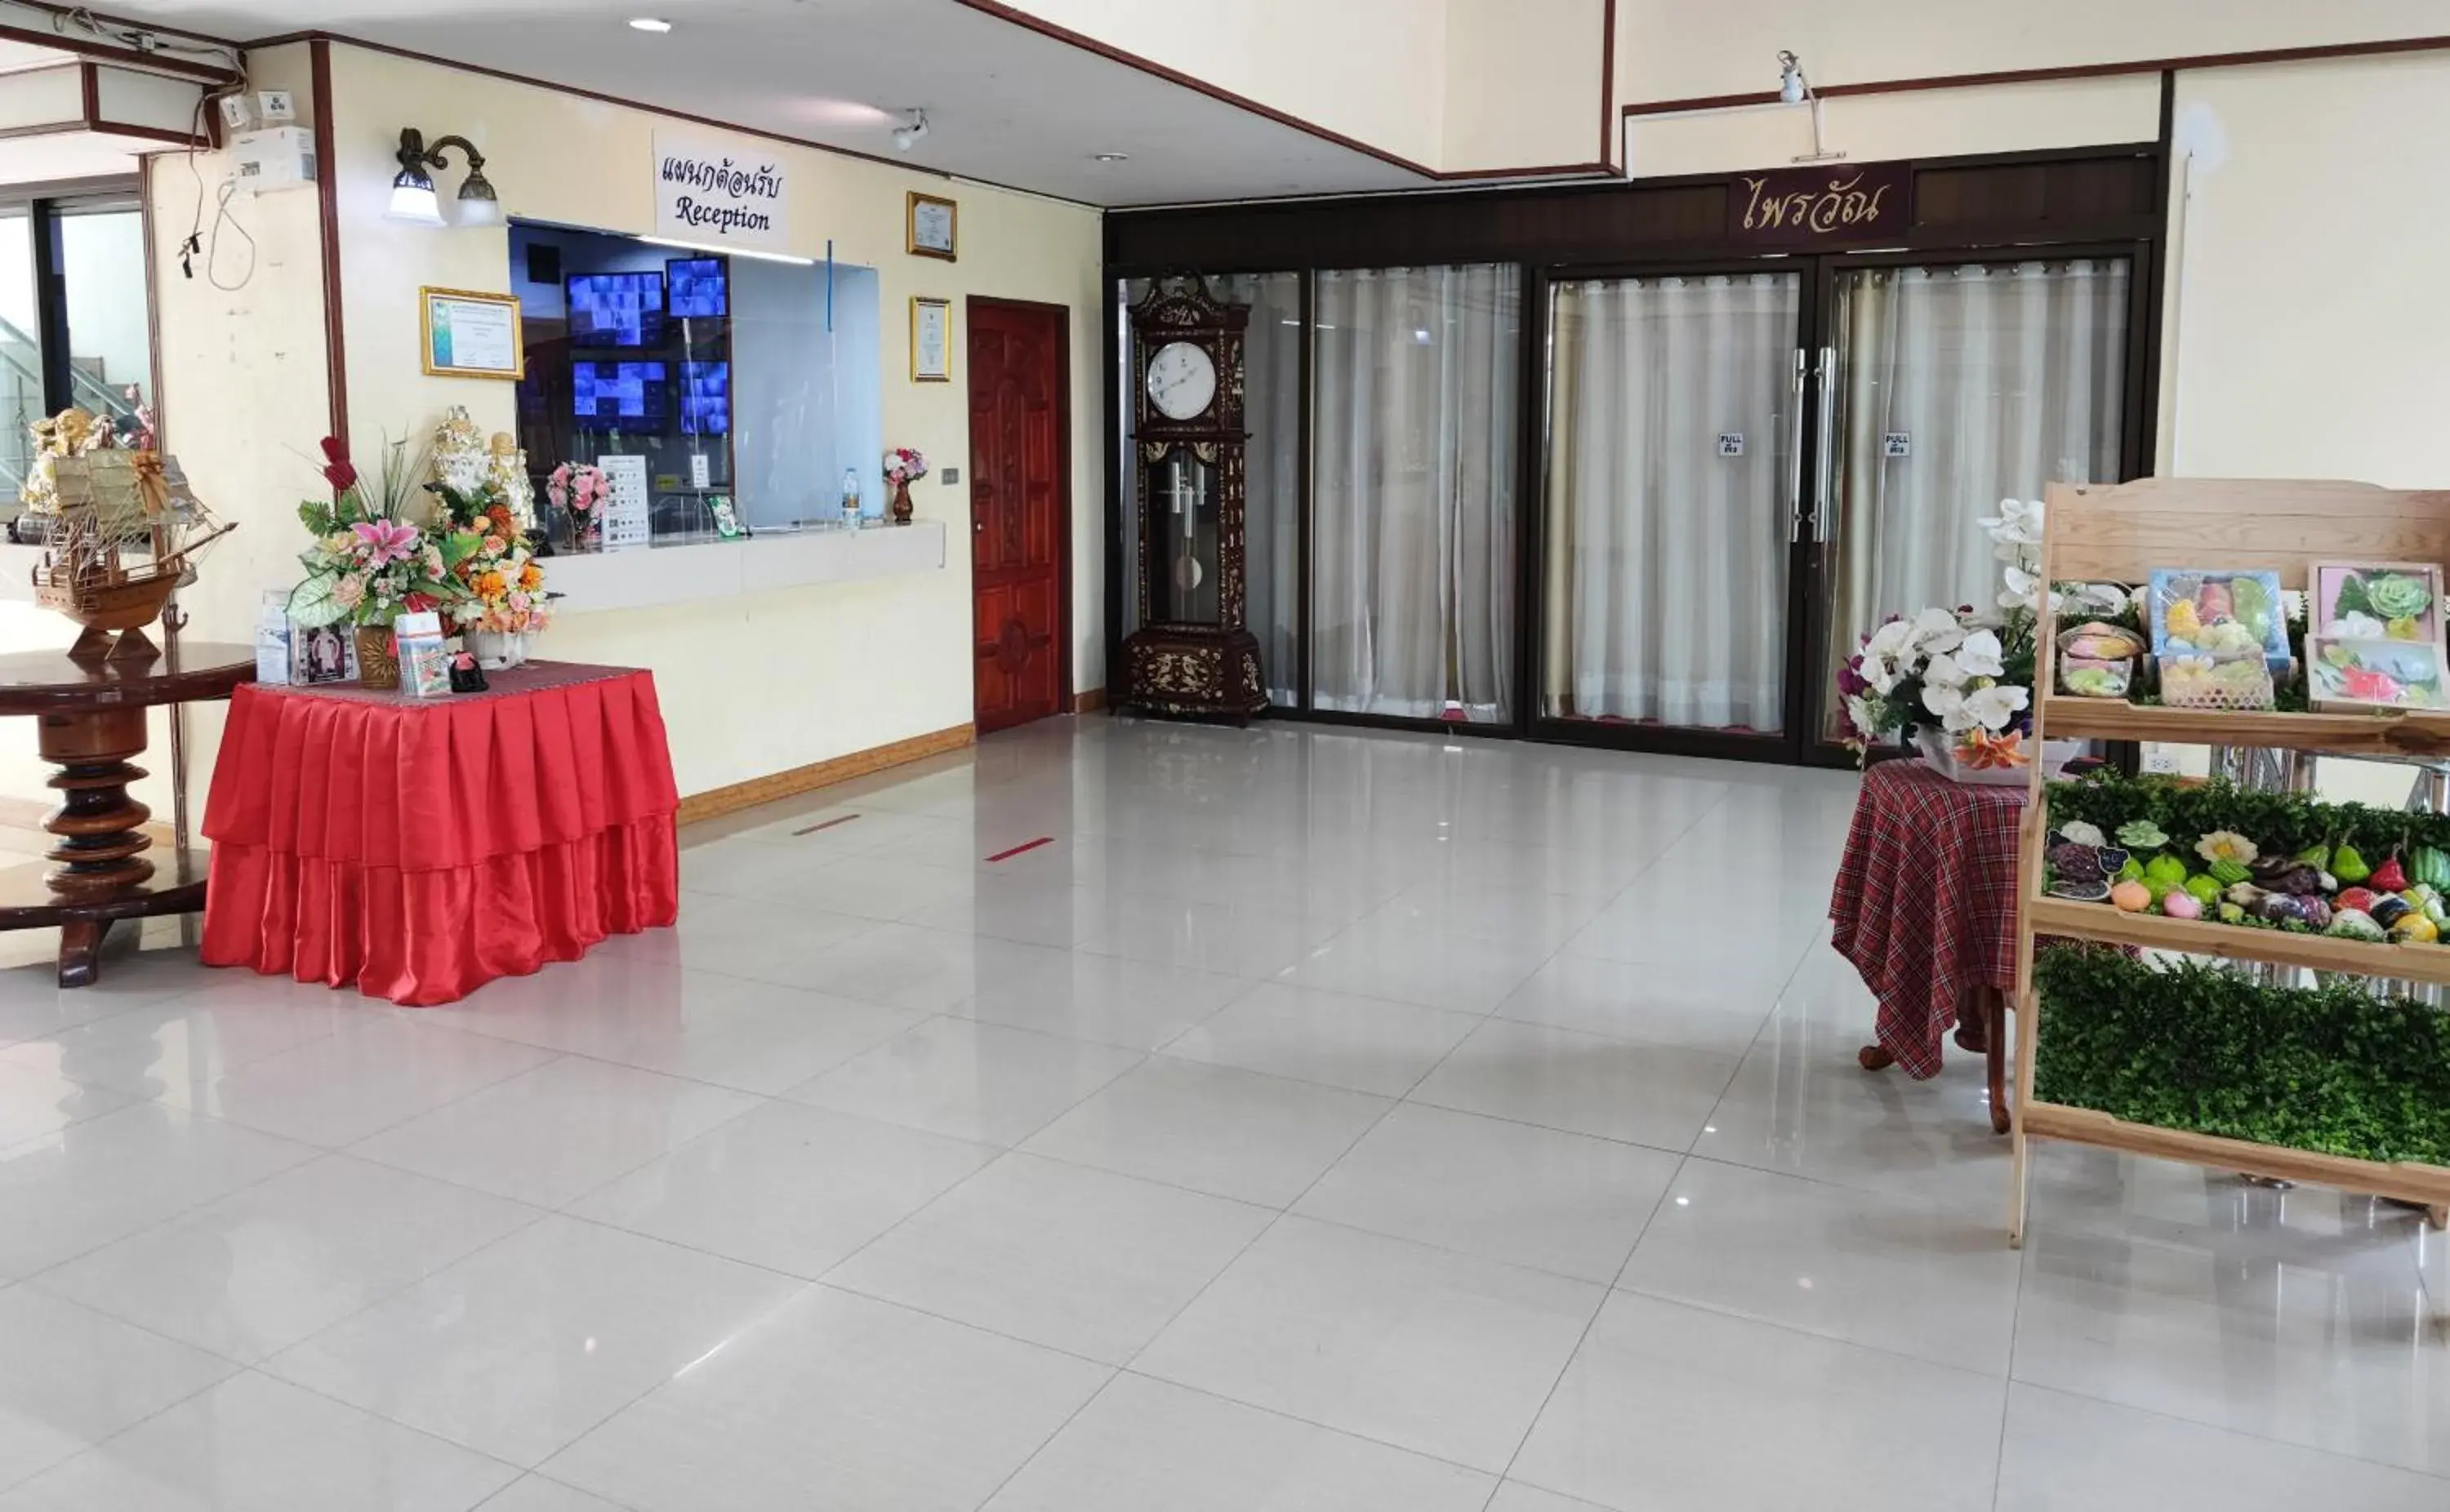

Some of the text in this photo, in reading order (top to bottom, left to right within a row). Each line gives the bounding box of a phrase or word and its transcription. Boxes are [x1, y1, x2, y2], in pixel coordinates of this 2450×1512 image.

[662, 157, 782, 198] แผนกต้อนรับ
[675, 196, 770, 234] Reception
[1740, 171, 1891, 233] ไพรวัณ
[1721, 435, 1741, 443] PULL
[1886, 435, 1908, 443] PULL
